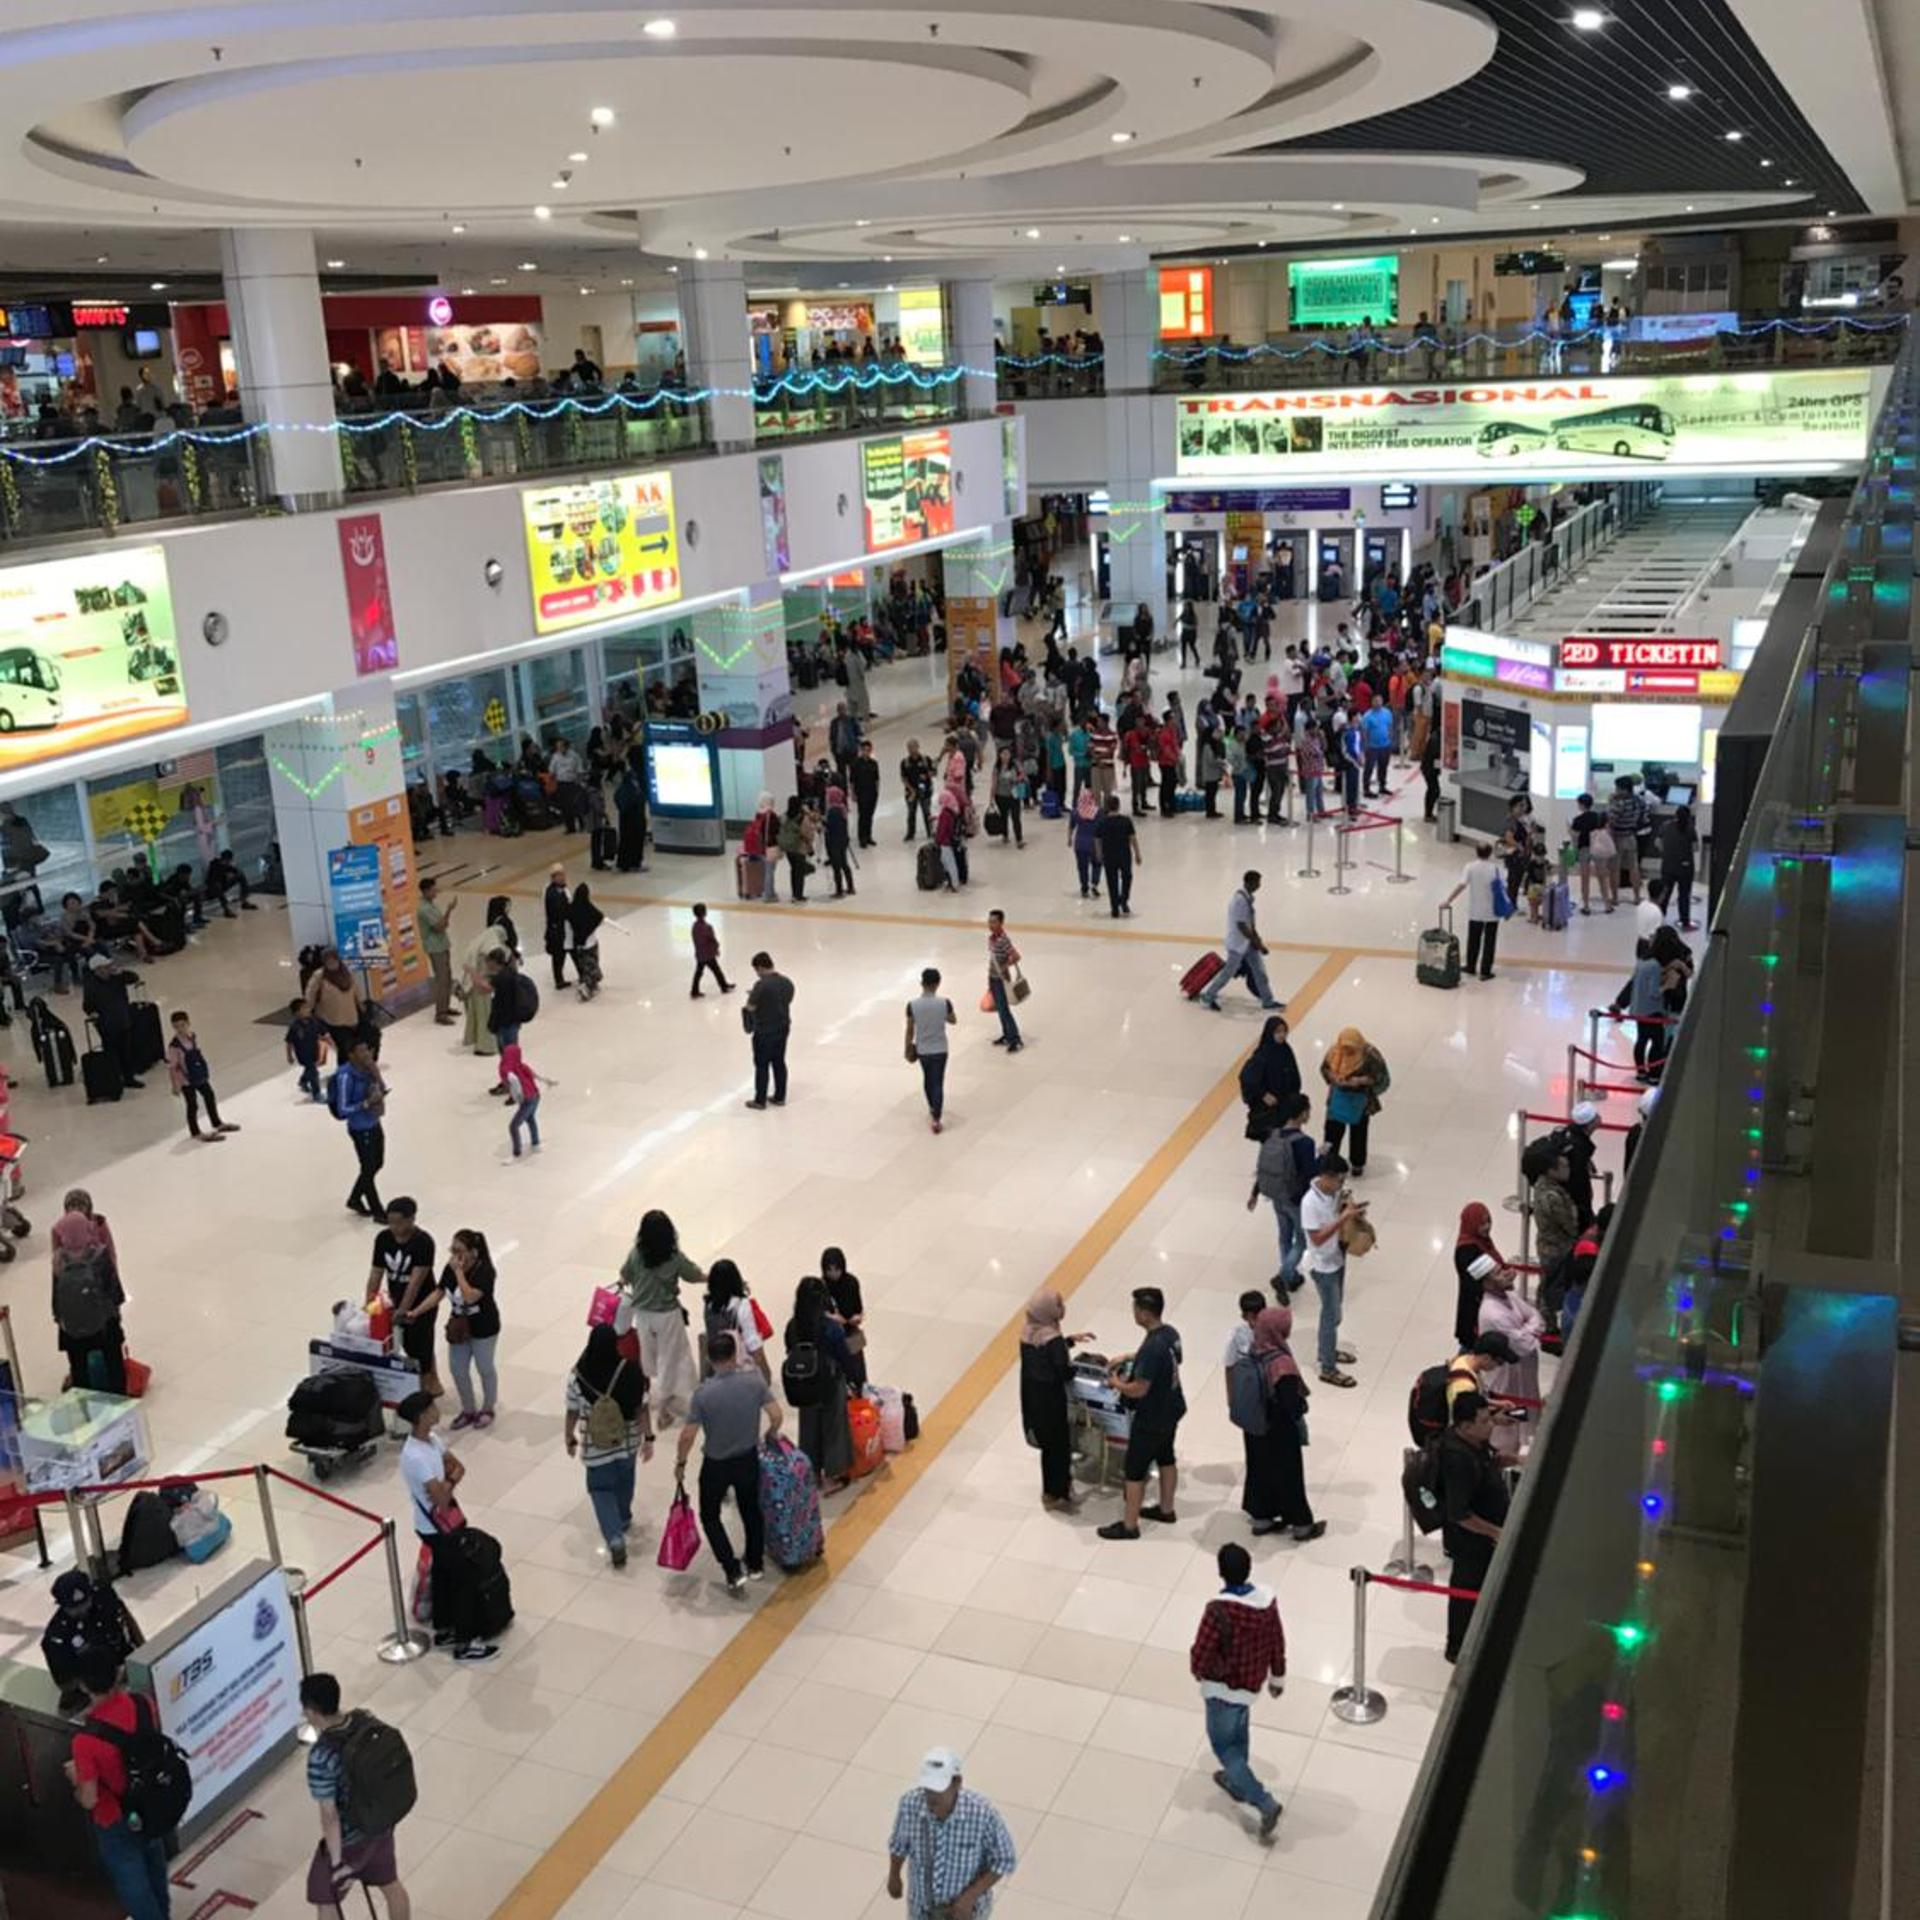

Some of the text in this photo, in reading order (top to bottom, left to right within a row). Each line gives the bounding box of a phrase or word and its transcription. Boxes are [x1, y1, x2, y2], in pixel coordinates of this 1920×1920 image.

[1179, 385, 1609, 413] TRANSNASIONAL
[1831, 392, 1862, 406] GPS
[1327, 428, 1399, 440] THE BIGGEST
[1327, 436, 1473, 450] INTERCITY BUS OPERATOR
[1609, 644, 1719, 665] TICKETIN
